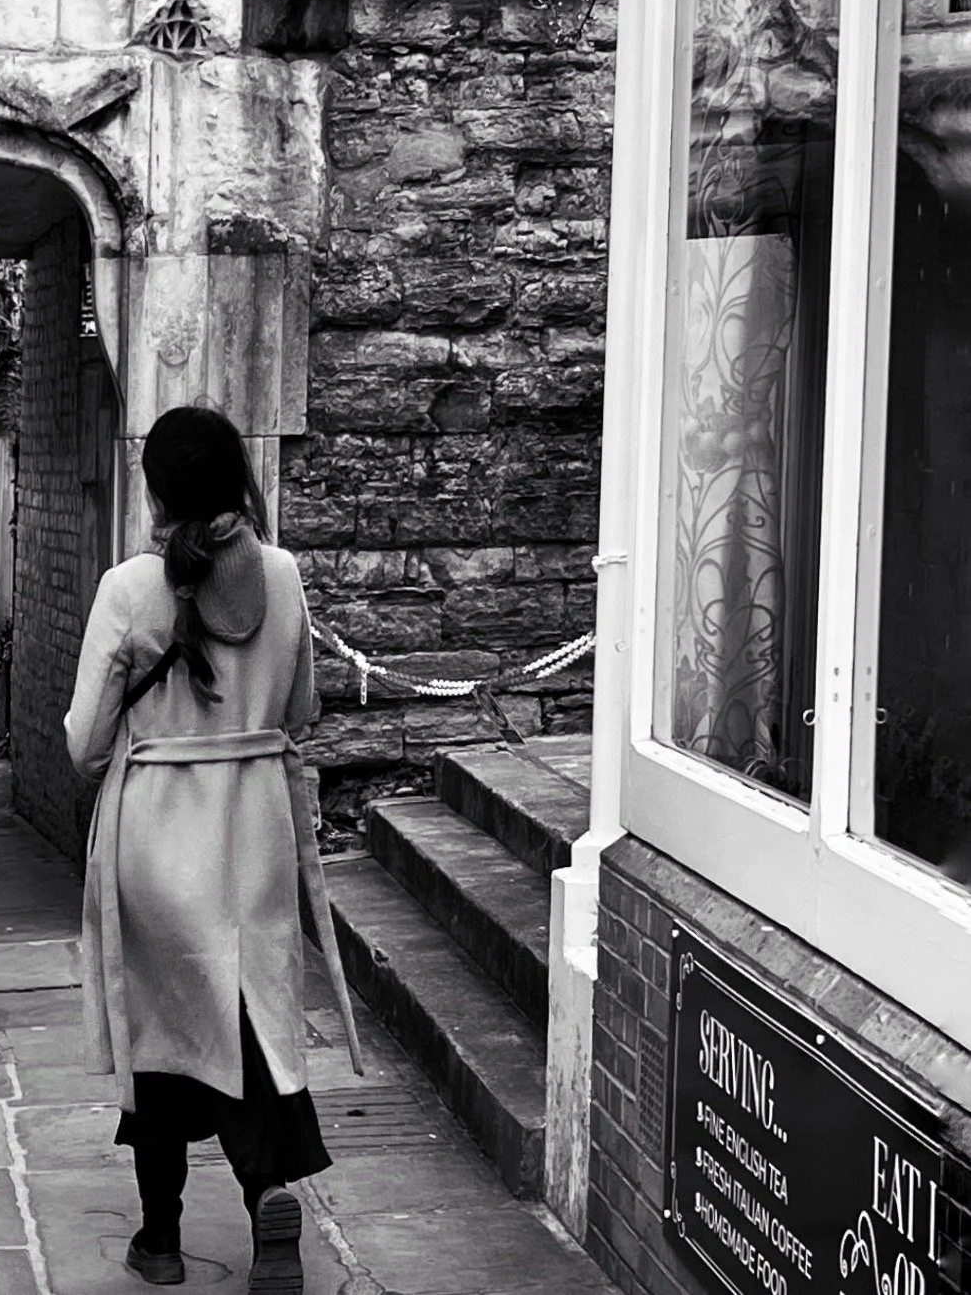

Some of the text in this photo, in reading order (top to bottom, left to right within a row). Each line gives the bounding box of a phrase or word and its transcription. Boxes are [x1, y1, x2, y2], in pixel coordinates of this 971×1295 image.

[703, 1105, 789, 1205] FINE ENGLISH TEA
[872, 1136, 921, 1243] EAT
[700, 1195, 788, 1295] HOMEMADE FOOD
[702, 1150, 813, 1280] FRESH ITALIAN COFFEE
